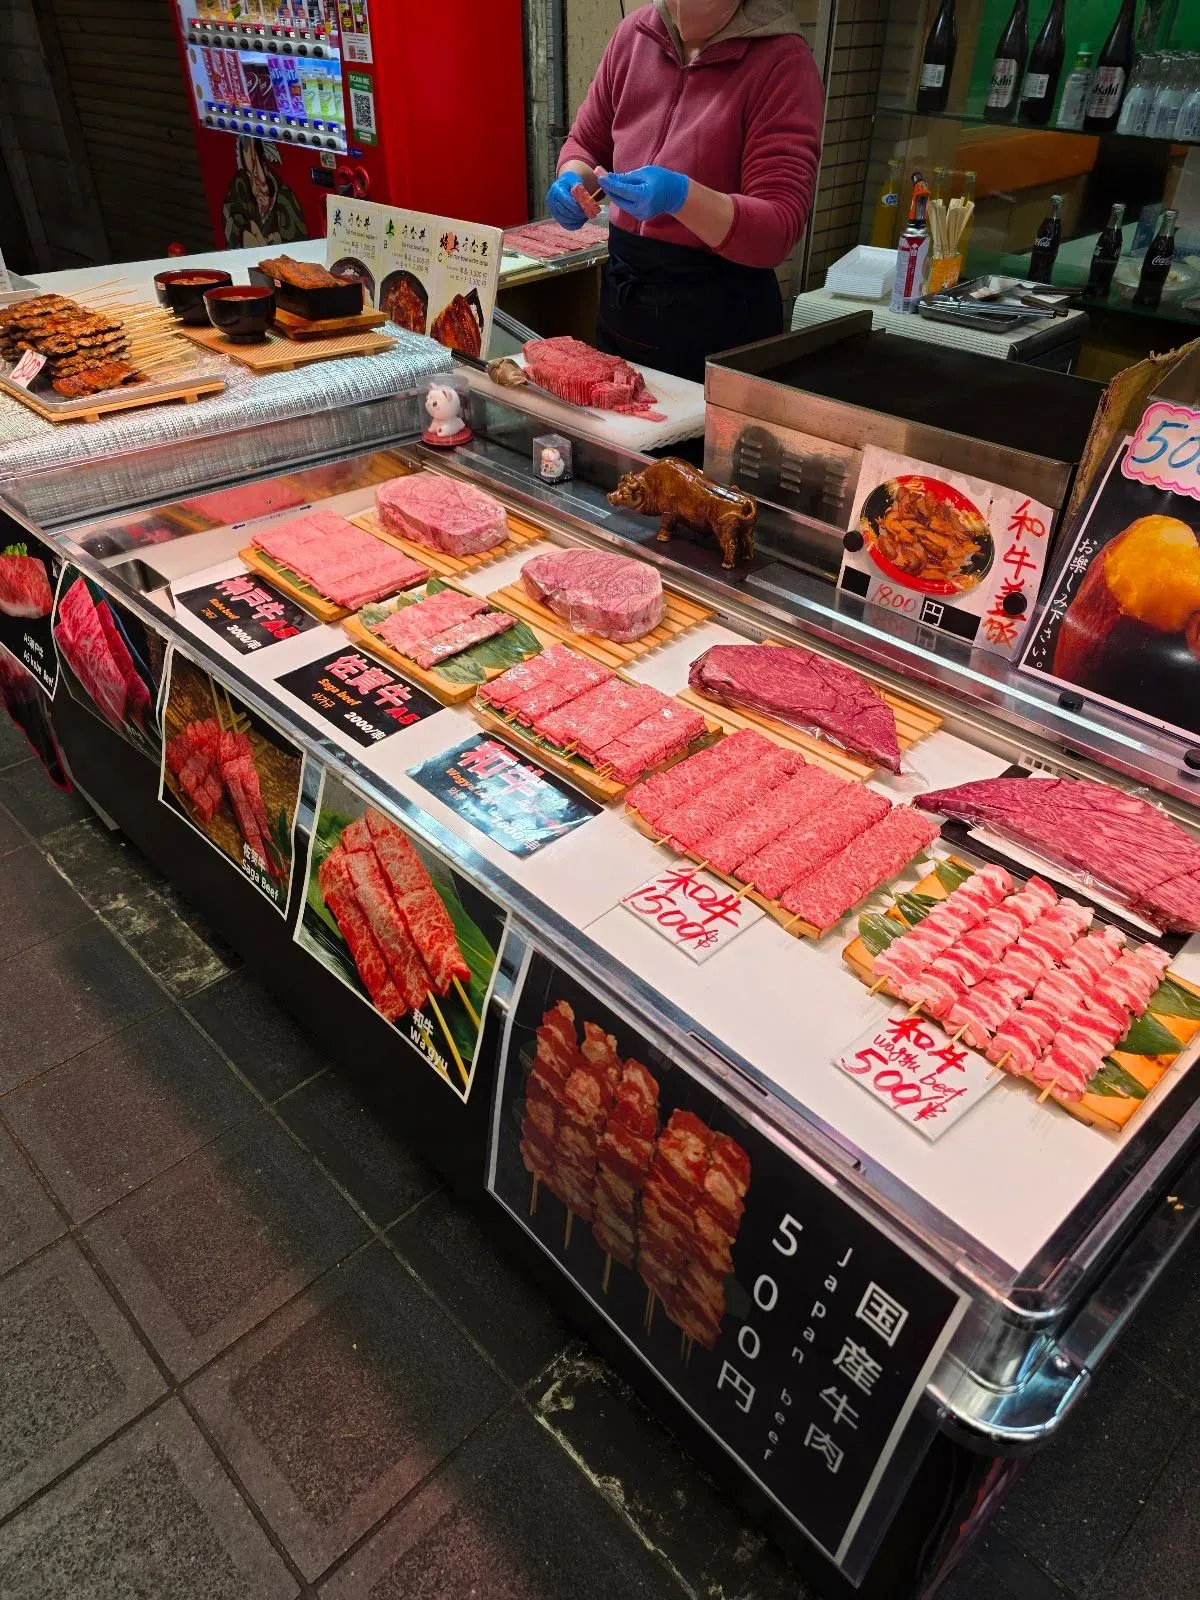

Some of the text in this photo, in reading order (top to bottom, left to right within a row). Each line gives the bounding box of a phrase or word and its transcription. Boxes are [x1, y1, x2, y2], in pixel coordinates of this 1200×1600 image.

[383, 239, 388, 249] B
[437, 252, 443, 263] C
[1130, 420, 1200, 475] 50
[214, 576, 300, 640] 神戸牛 A5
[871, 583, 945, 628] 1800 円
[1031, 537, 1098, 668] お楽しみ下さい。
[318, 678, 362, 706] Saga beef
[324, 653, 420, 725] 佐賀牛 A5
[456, 739, 546, 798] 和牛
[242, 858, 279, 902] Saga Beef
[656, 867, 743, 928] 和牛
[412, 1007, 434, 1036] 和牛
[885, 1017, 969, 1075] 和牛
[716, 1212, 804, 1414] 500円
[763, 1247, 853, 1461] Japan beef
[804, 1281, 910, 1474] 国産牛肉
